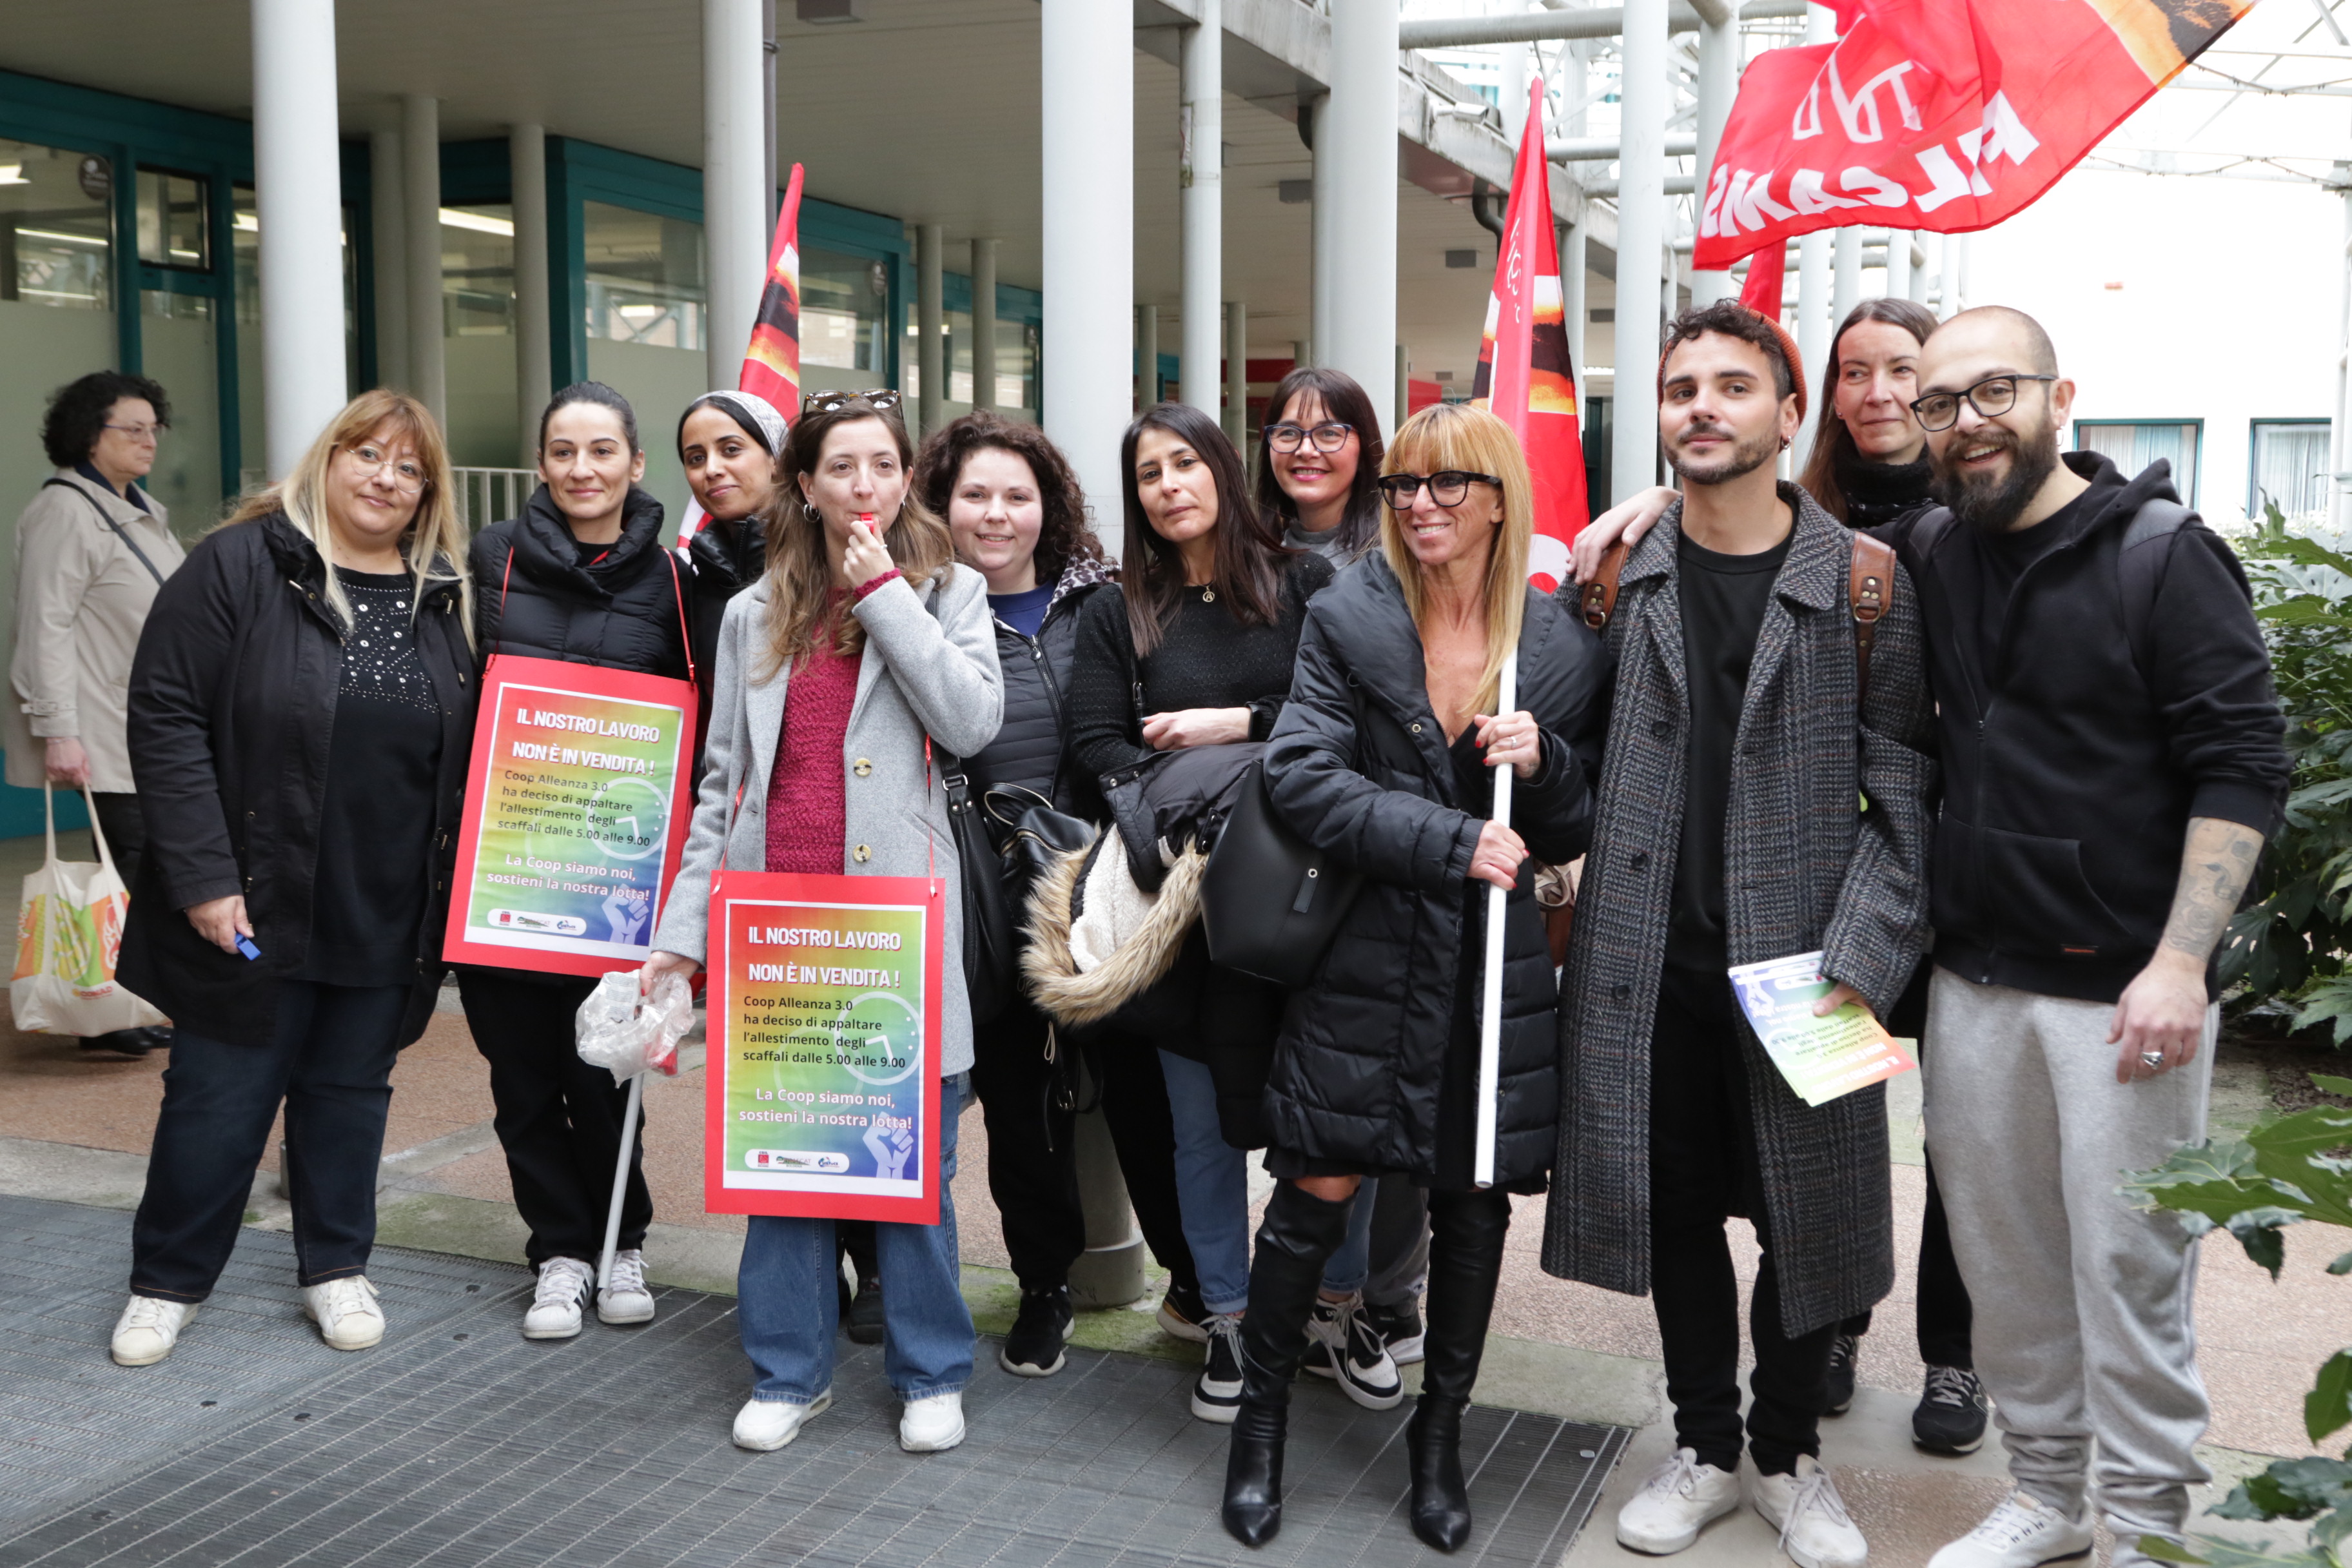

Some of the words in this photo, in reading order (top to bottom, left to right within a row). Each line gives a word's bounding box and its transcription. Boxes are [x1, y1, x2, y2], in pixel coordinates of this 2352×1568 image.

[516, 708, 531, 725] IL
[534, 710, 596, 734] NOSTRO
[598, 720, 660, 743] LAVORO
[512, 741, 547, 761] NON
[549, 743, 560, 763] È
[562, 748, 579, 765] IN
[581, 750, 646, 775] VENDITA
[505, 770, 534, 785] Coop
[538, 774, 588, 789] Alleanza
[591, 781, 608, 792] 3.0
[502, 786, 516, 796] ha
[521, 789, 558, 801] deciso
[562, 794, 573, 804] di
[576, 796, 632, 812] appaltare
[588, 814, 616, 827] degli
[498, 820, 541, 833] scaffali
[544, 824, 573, 837] dalle
[576, 829, 600, 840] 5.00
[603, 833, 623, 843] alle
[627, 835, 651, 847] 9.00
[505, 854, 522, 866] La
[526, 856, 562, 874] Coop
[565, 861, 607, 875] siamo
[611, 867, 636, 881] noi,
[486, 872, 543, 888] sostieni
[547, 877, 559, 890] la
[563, 882, 609, 896] nostra
[612, 885, 650, 901] lotta!
[749, 926, 764, 945] IL
[766, 927, 832, 948] NOSTRO
[834, 930, 901, 951] LAVORO
[749, 963, 783, 983] NON
[787, 961, 798, 983] È
[800, 966, 817, 985] IN
[819, 967, 891, 988] VENDITA
[744, 996, 774, 1010] Coop
[778, 997, 831, 1010] Alleanza
[835, 1000, 853, 1010] 3.0
[744, 1014, 759, 1024] ha
[763, 1015, 802, 1026] deciso
[806, 1017, 817, 1027] di
[821, 1019, 882, 1031] appaltare
[836, 1037, 866, 1050] degli
[1839, 1031, 1861, 1041] deciso
[1860, 1033, 1877, 1041] Coop
[1829, 1041, 1858, 1054] Alleanza
[1856, 1051, 1867, 1060] È
[1863, 1043, 1887, 1056] NON
[743, 1051, 789, 1062] scaffali
[792, 1052, 822, 1064] dalle
[826, 1054, 850, 1064] 5.00
[854, 1056, 877, 1066] alle
[880, 1057, 905, 1068] 9.00
[1845, 1054, 1857, 1063] IN
[1888, 1056, 1899, 1064] IL
[1849, 1060, 1889, 1079] NOSTRO
[756, 1088, 773, 1101] La
[778, 1089, 815, 1106] Coop
[819, 1090, 864, 1105] siamo
[868, 1093, 896, 1109] noi,
[739, 1110, 798, 1123] sostieni
[802, 1111, 815, 1124] la
[819, 1113, 867, 1127] nostra
[872, 1113, 912, 1129] lotta!
